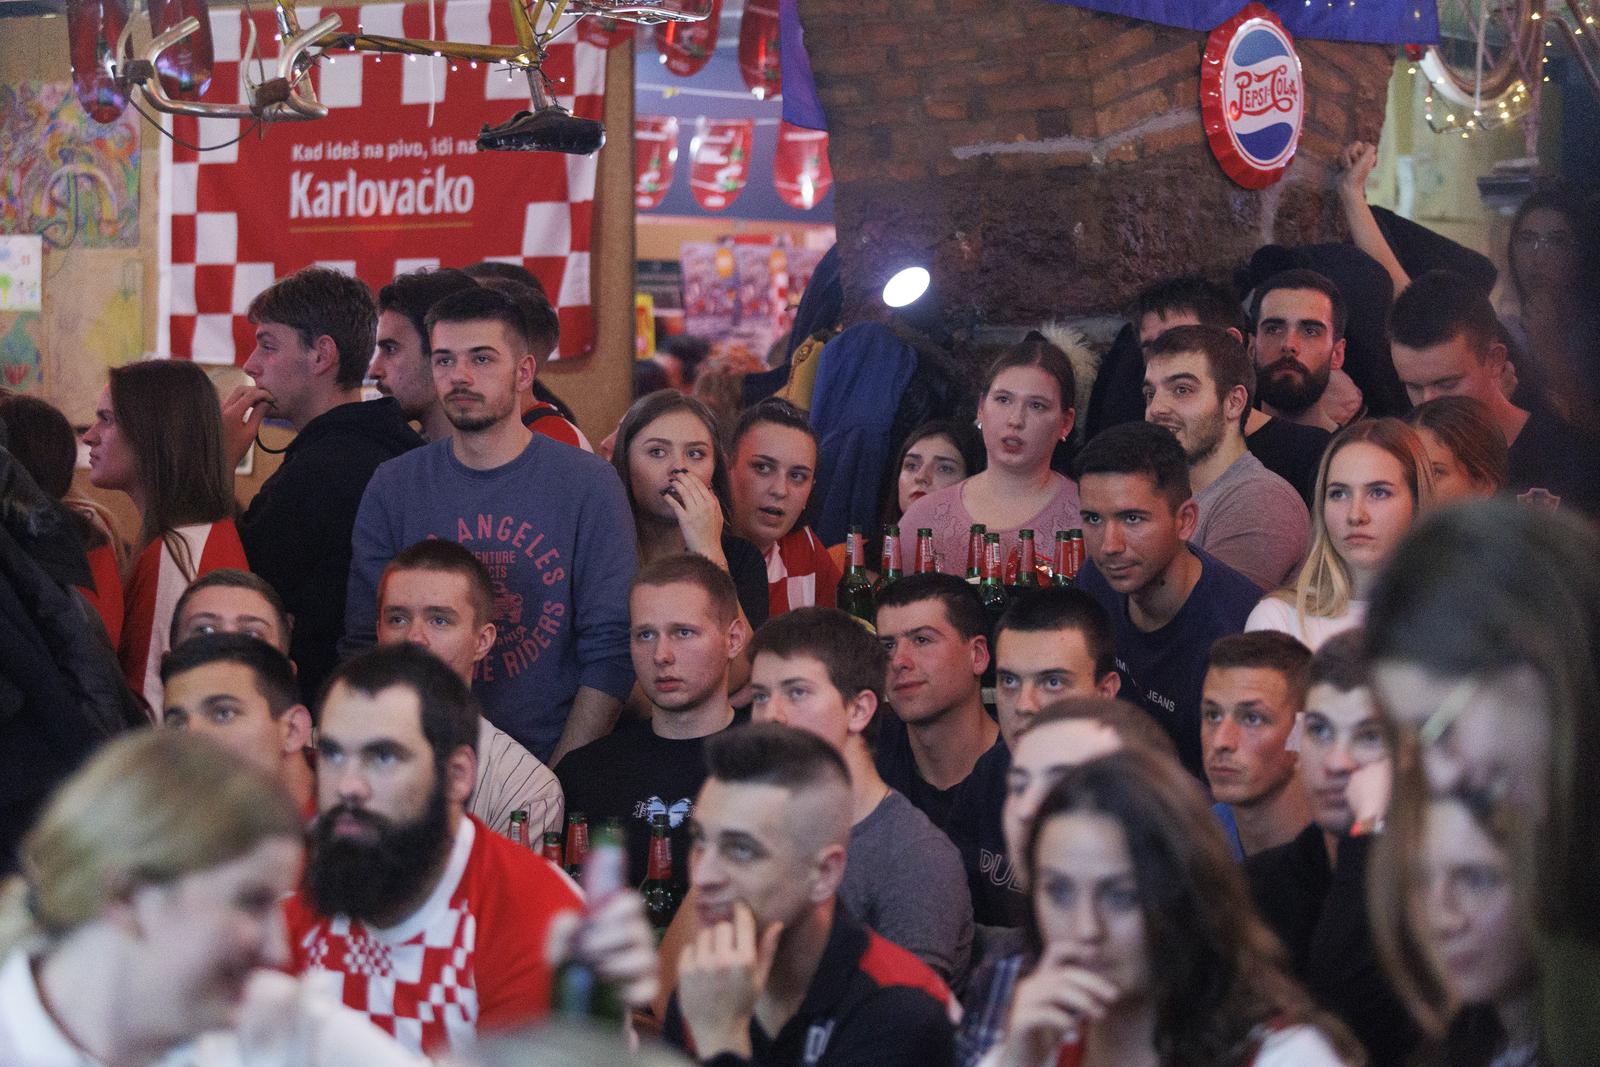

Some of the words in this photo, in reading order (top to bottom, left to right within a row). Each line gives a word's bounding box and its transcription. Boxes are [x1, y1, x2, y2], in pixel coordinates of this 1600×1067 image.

[292, 143, 323, 161] Kad
[326, 139, 360, 160] ideš
[363, 144, 384, 159] na
[386, 138, 429, 163] pivo,
[431, 136, 453, 156] idi
[456, 139, 478, 155] na
[289, 164, 475, 219] Karlovačko
[457, 513, 565, 586] ANGELES
[502, 600, 566, 679] RIDERS
[1146, 689, 1175, 712] JEANS
